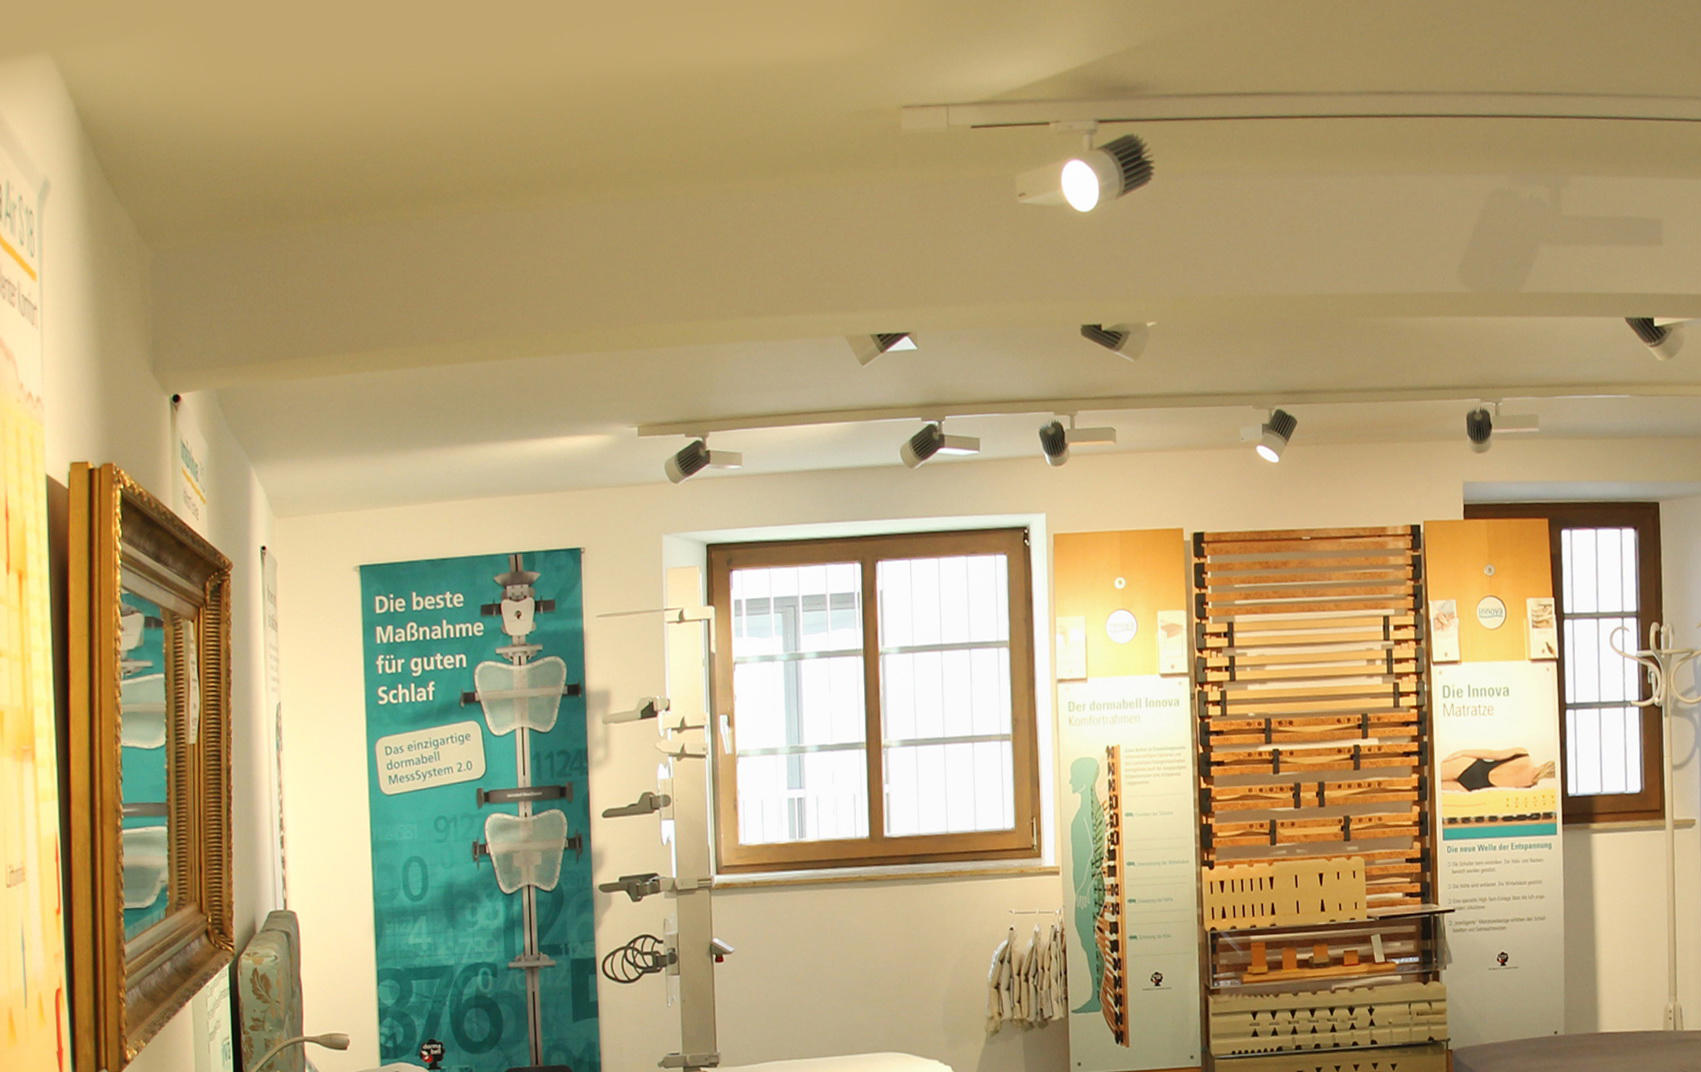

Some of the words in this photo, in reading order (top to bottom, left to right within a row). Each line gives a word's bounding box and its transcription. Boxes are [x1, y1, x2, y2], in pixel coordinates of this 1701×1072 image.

[374, 594, 406, 614] Die
[412, 592, 464, 612] beste
[376, 620, 484, 644] Maßnahme
[376, 655, 405, 674] für
[410, 653, 467, 677] guten
[377, 681, 436, 705] Schlaf
[1442, 685, 1463, 698] Die
[1468, 684, 1510, 698] Innova
[1442, 703, 1494, 717] Matratze
[384, 745, 404, 757] Das
[407, 733, 472, 752] einzigartige
[386, 752, 441, 770] dormabell
[388, 765, 454, 785] MessSystem
[457, 760, 473, 773] 2.0
